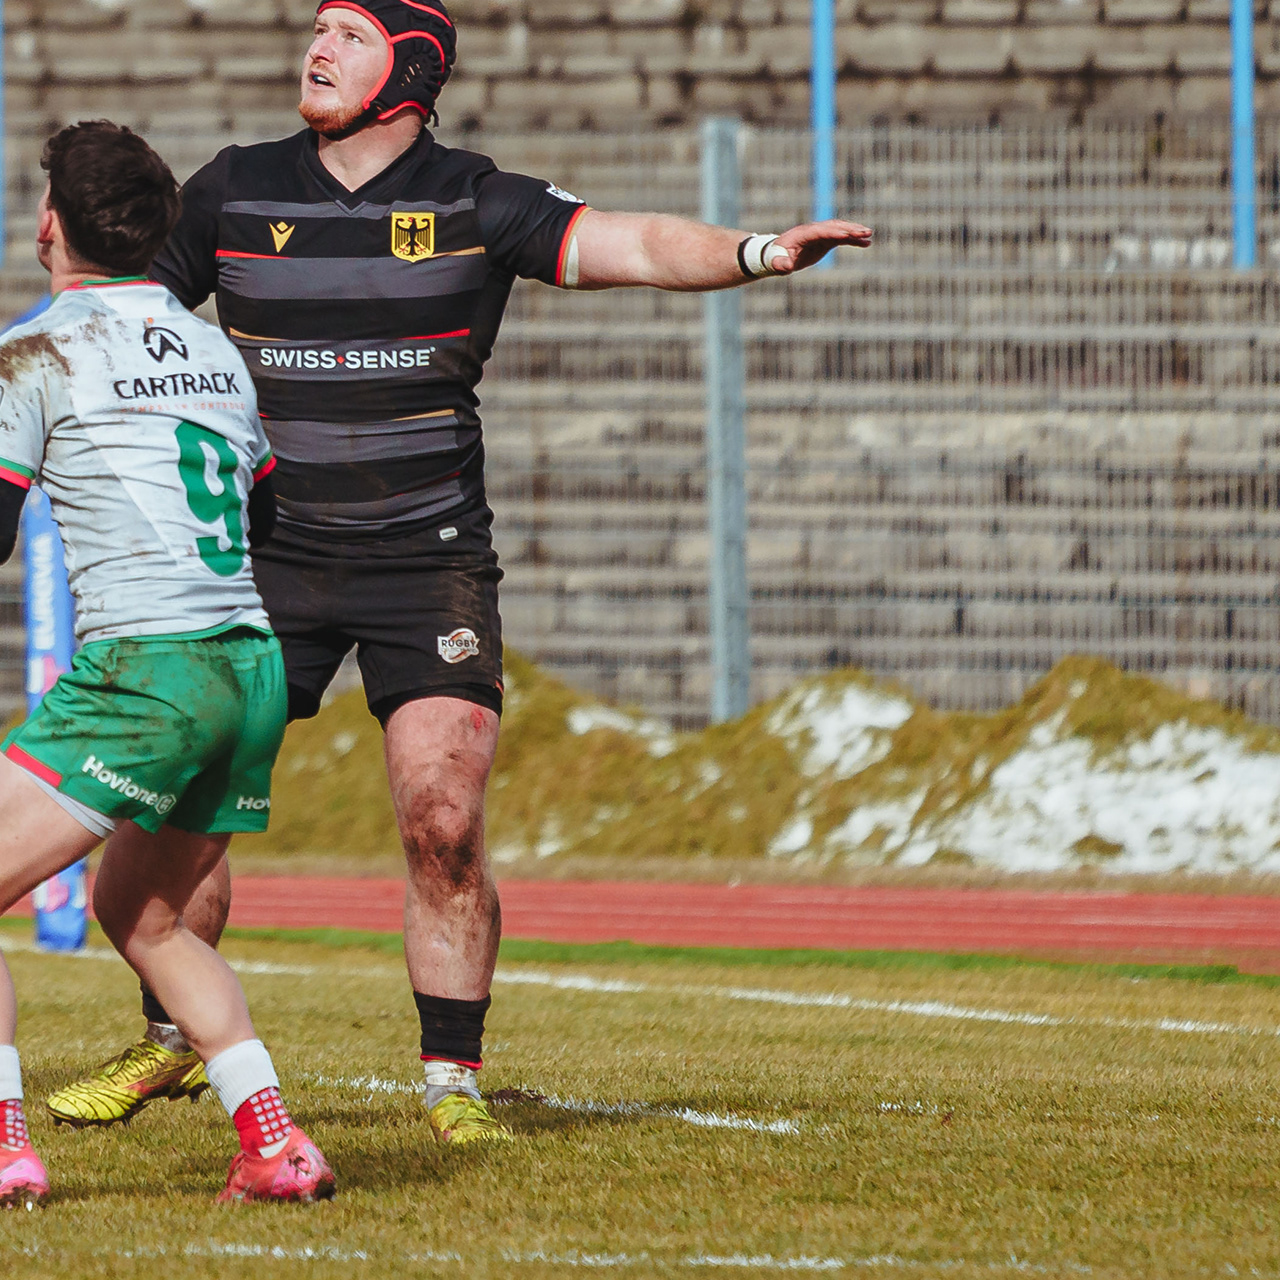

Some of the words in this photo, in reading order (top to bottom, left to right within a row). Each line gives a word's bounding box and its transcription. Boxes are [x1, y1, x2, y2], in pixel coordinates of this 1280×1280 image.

[113, 371, 242, 400] CARTRACK
[175, 420, 247, 577] 9
[441, 638, 477, 649] RUGBY
[81, 754, 158, 807] Hovione
